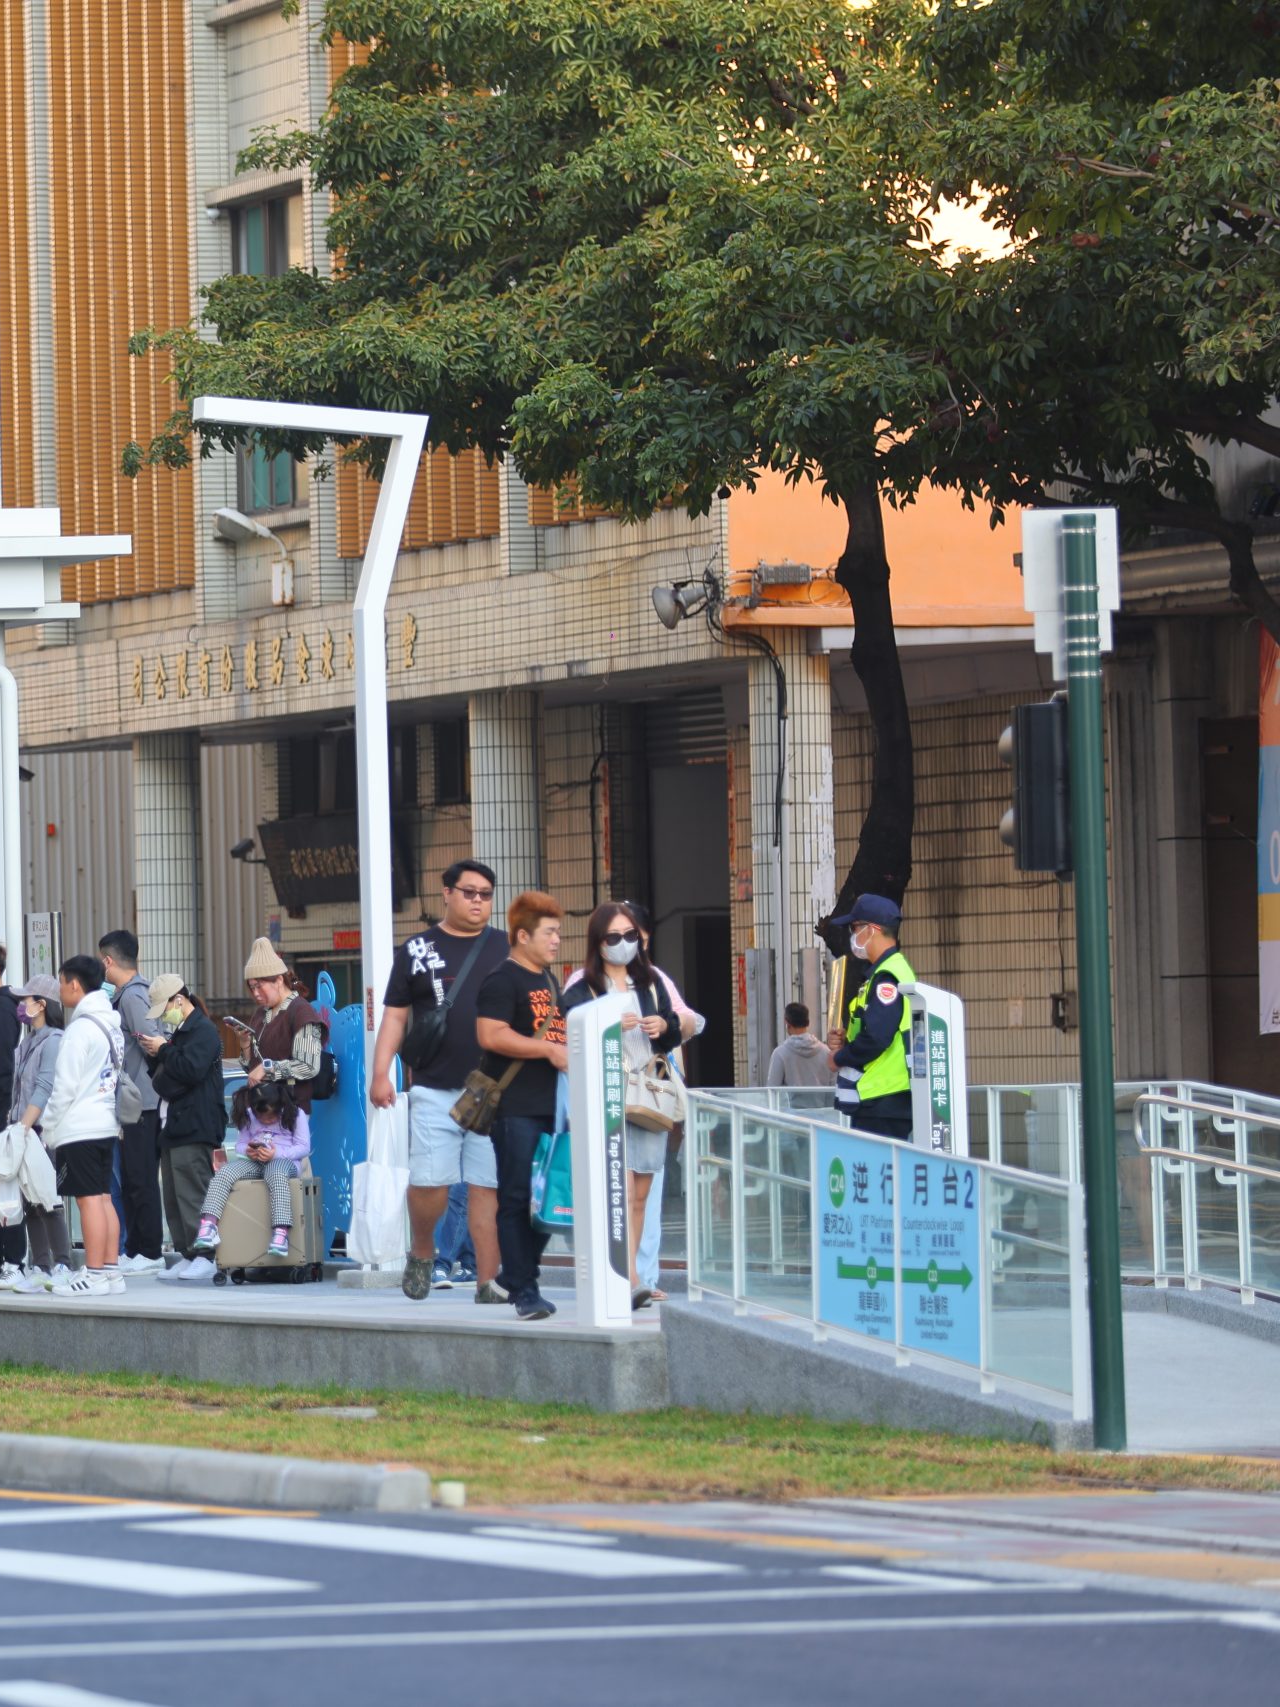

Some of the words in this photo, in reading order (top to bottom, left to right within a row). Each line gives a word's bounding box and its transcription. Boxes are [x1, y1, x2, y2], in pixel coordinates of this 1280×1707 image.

[132, 612, 418, 705] 豐凍食品股份有限公司
[605, 1039, 622, 1119] 進站請刷卡
[931, 1030, 947, 1107] 進站請刷卡
[610, 1133, 621, 1158] Tap
[932, 1121, 942, 1145] Tap
[611, 1159, 622, 1191] Card
[829, 1173, 845, 1194] C24
[852, 1160, 975, 1210] 逆行月台2
[613, 1192, 623, 1206] to
[611, 1207, 623, 1242] Enter
